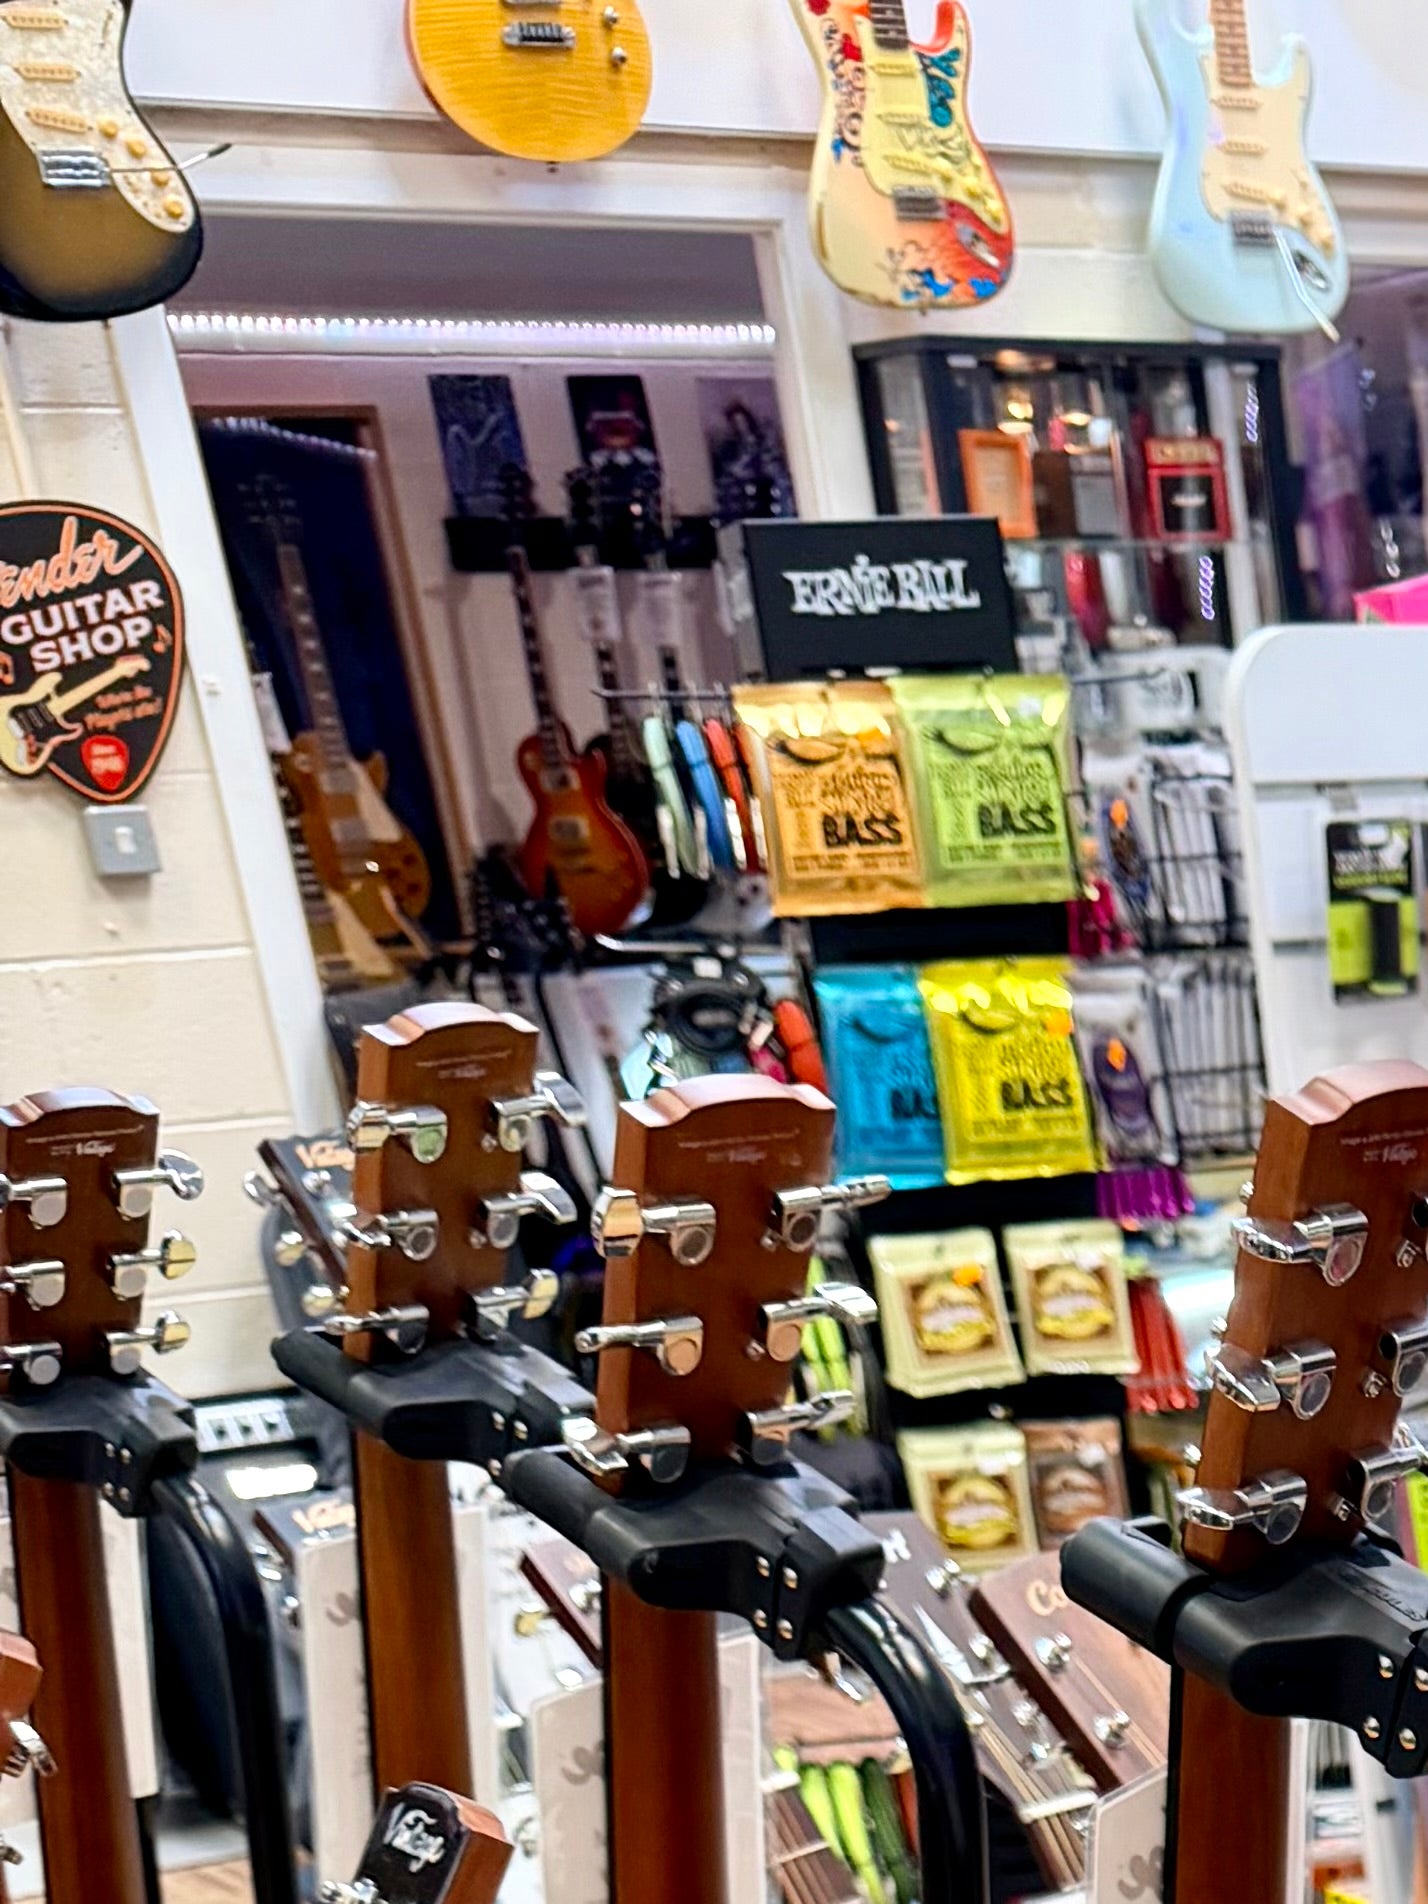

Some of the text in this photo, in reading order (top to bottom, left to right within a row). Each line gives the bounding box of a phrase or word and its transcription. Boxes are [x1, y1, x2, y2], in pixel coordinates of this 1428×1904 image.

[0, 516, 144, 609] ender
[783, 553, 981, 616] ERNIE BALL
[1, 579, 164, 645] GUITAR
[30, 616, 152, 672] SHOP
[823, 812, 902, 847] BASS
[978, 802, 1056, 837] BASS
[1026, 1579, 1067, 1617] Co
